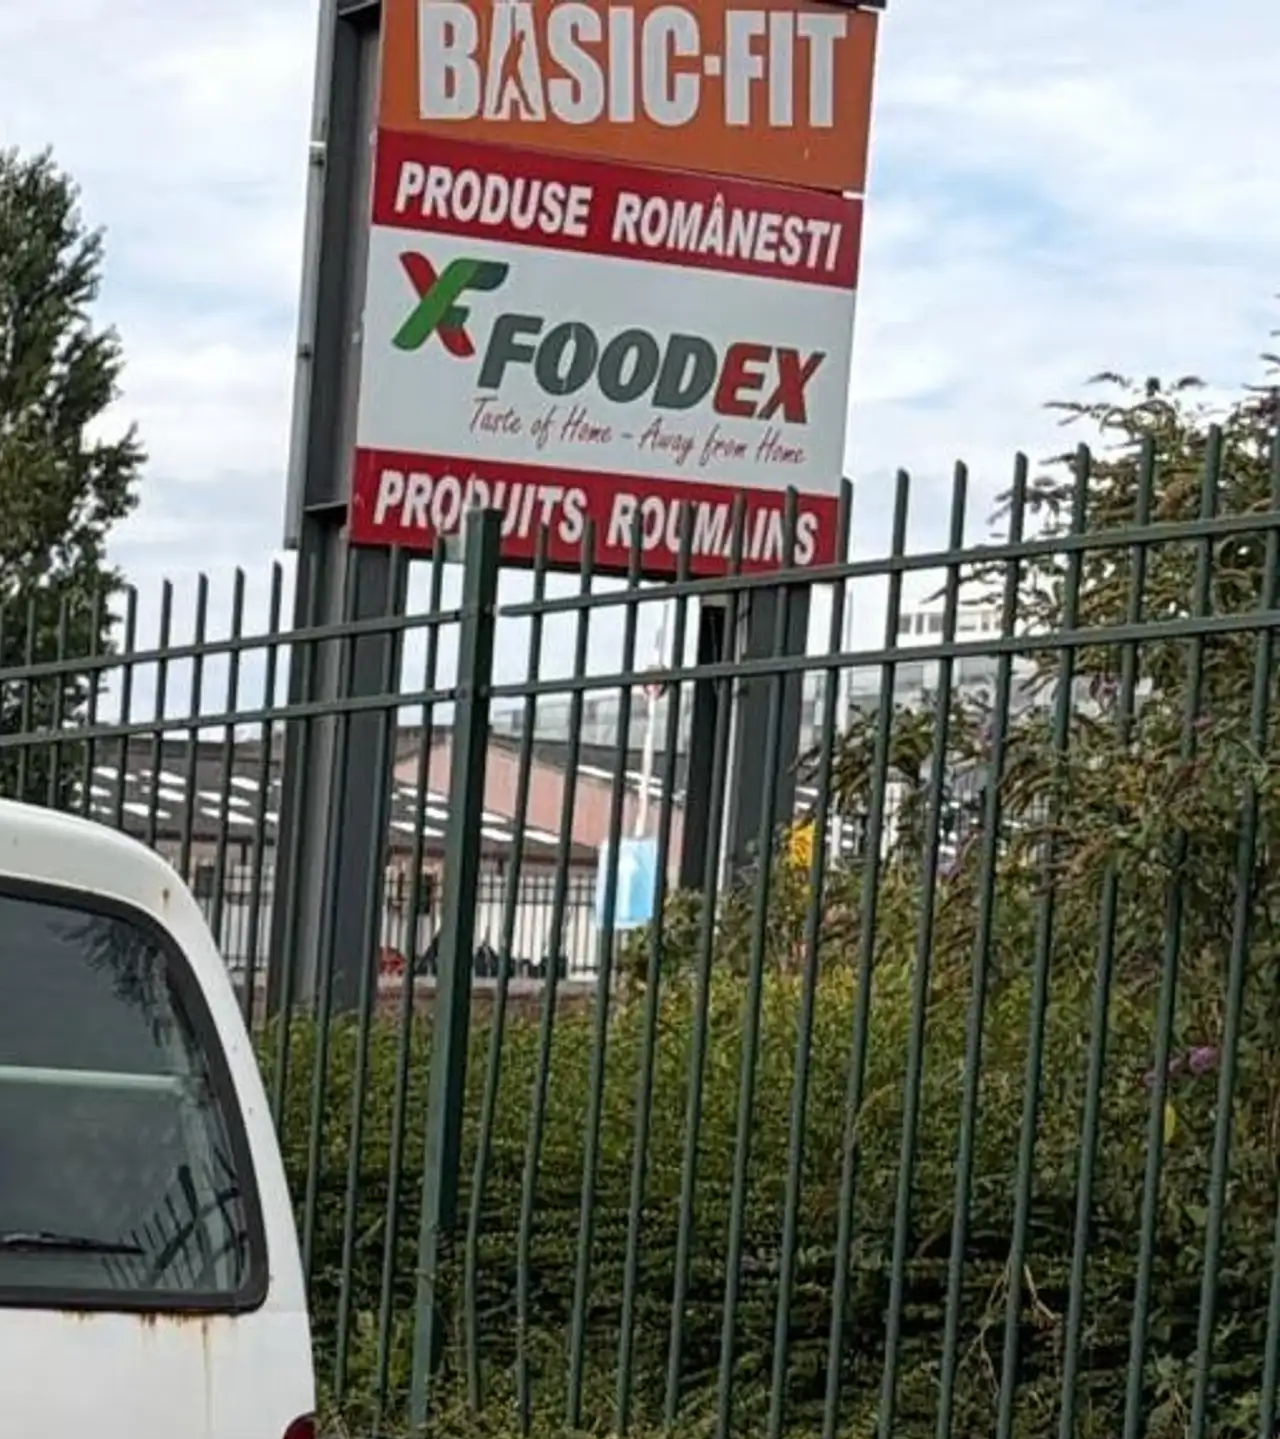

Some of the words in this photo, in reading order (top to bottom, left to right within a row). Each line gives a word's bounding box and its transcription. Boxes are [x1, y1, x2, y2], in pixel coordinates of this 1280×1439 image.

[418, 0, 848, 128] BASIC-FIT
[394, 160, 593, 238] PRODUSE
[611, 192, 842, 272] ROMÂNESTI
[477, 313, 826, 425] FOODEX
[469, 396, 523, 435] Taste
[531, 405, 553, 449] of
[560, 403, 612, 445] Home
[638, 415, 694, 465] Away
[699, 423, 747, 467] from
[755, 426, 808, 465] Home
